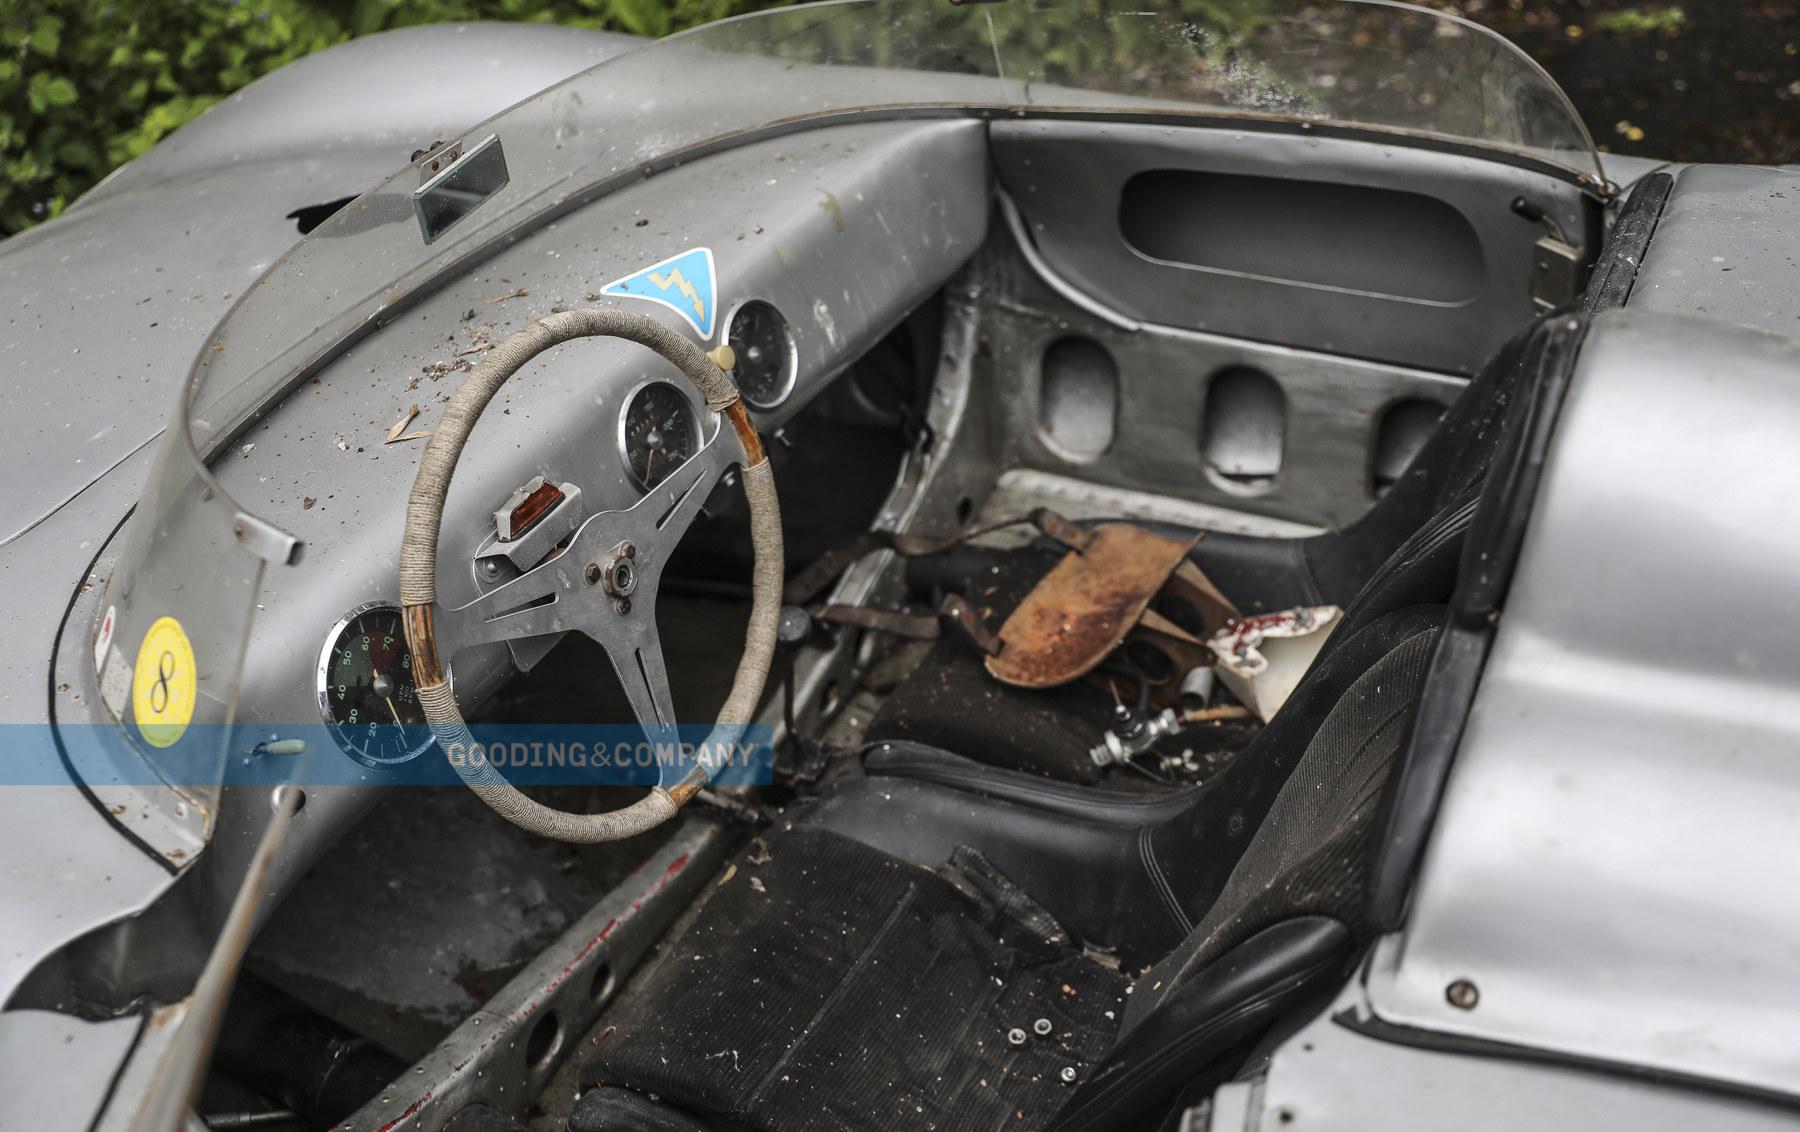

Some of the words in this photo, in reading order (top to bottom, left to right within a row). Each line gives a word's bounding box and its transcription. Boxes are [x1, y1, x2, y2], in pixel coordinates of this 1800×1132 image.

[361, 636, 370, 651] 60
[383, 636, 392, 650] 70
[343, 650, 352, 666] 50
[338, 684, 346, 701] 40
[349, 708, 358, 724] 30
[369, 721, 377, 737] 20
